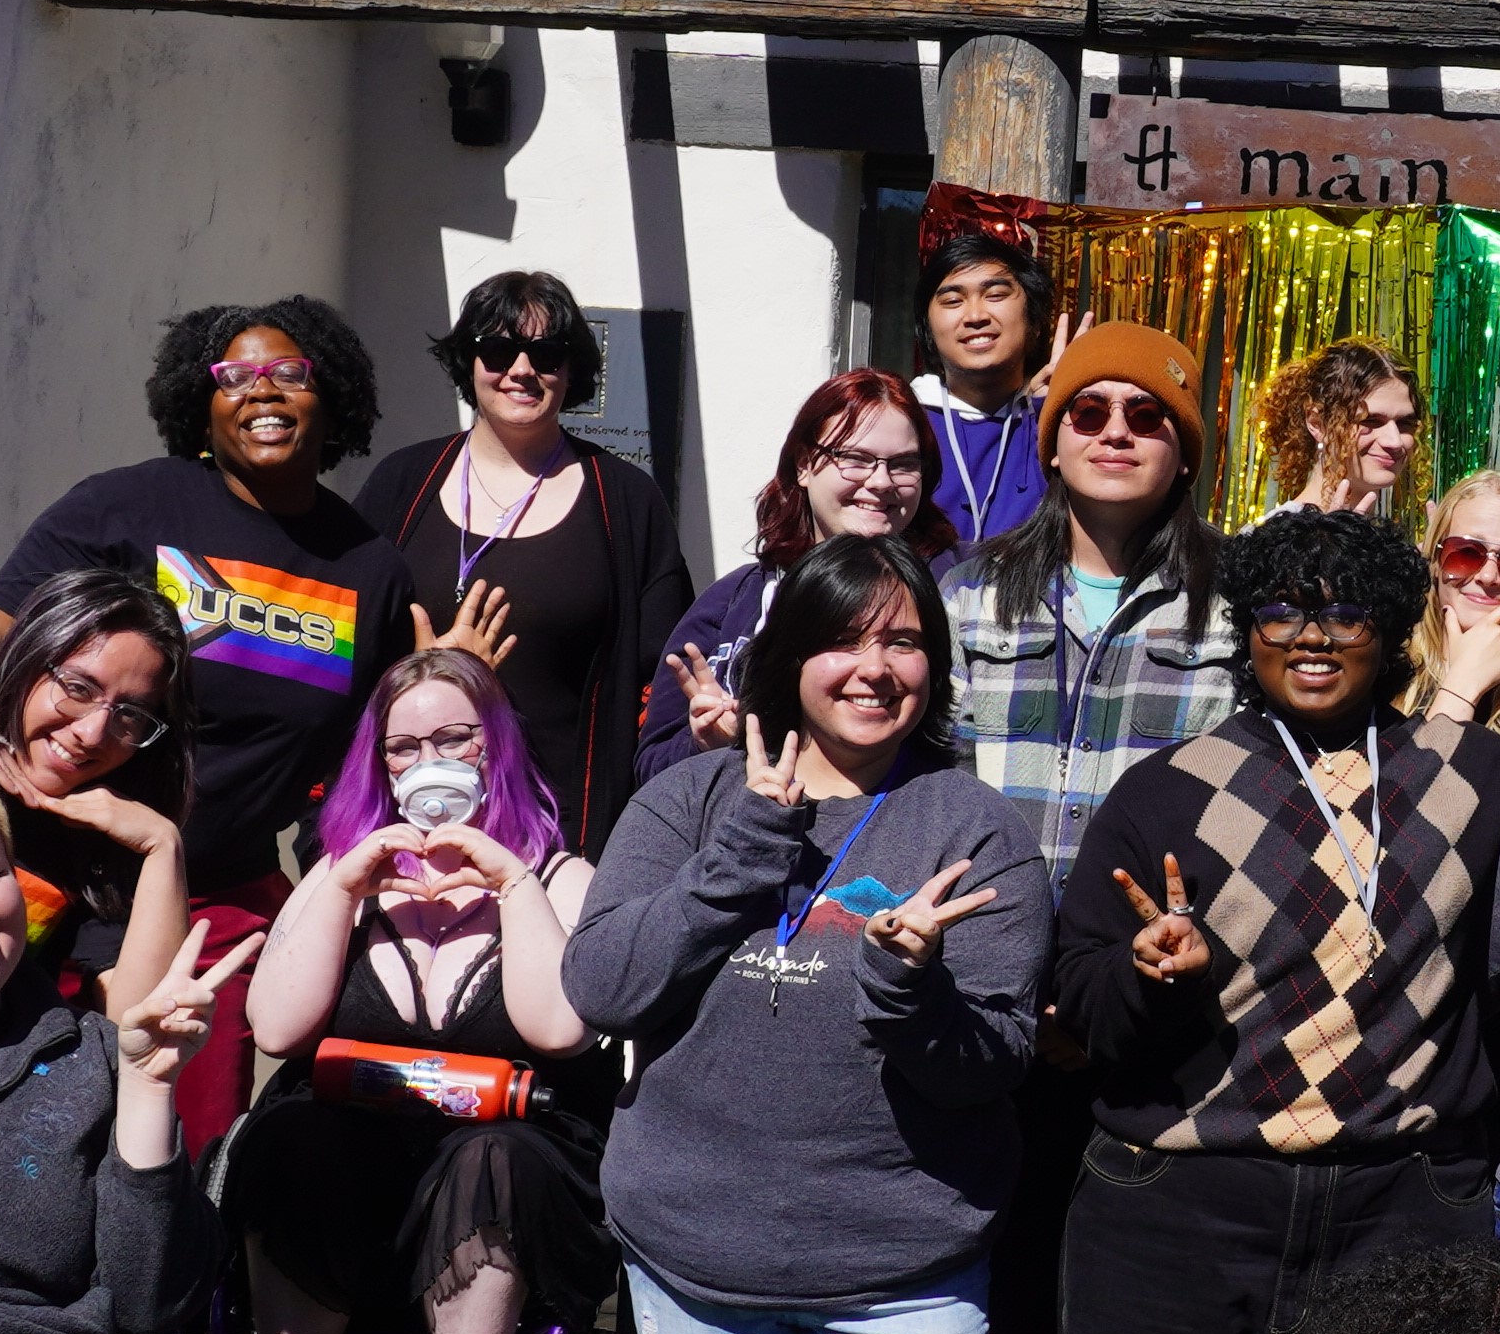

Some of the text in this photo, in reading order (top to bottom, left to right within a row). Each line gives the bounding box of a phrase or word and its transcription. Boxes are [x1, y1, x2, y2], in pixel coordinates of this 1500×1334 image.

[1239, 126, 1453, 205] main
[189, 581, 337, 655] UCCS
[741, 969, 765, 980] ROCKY
